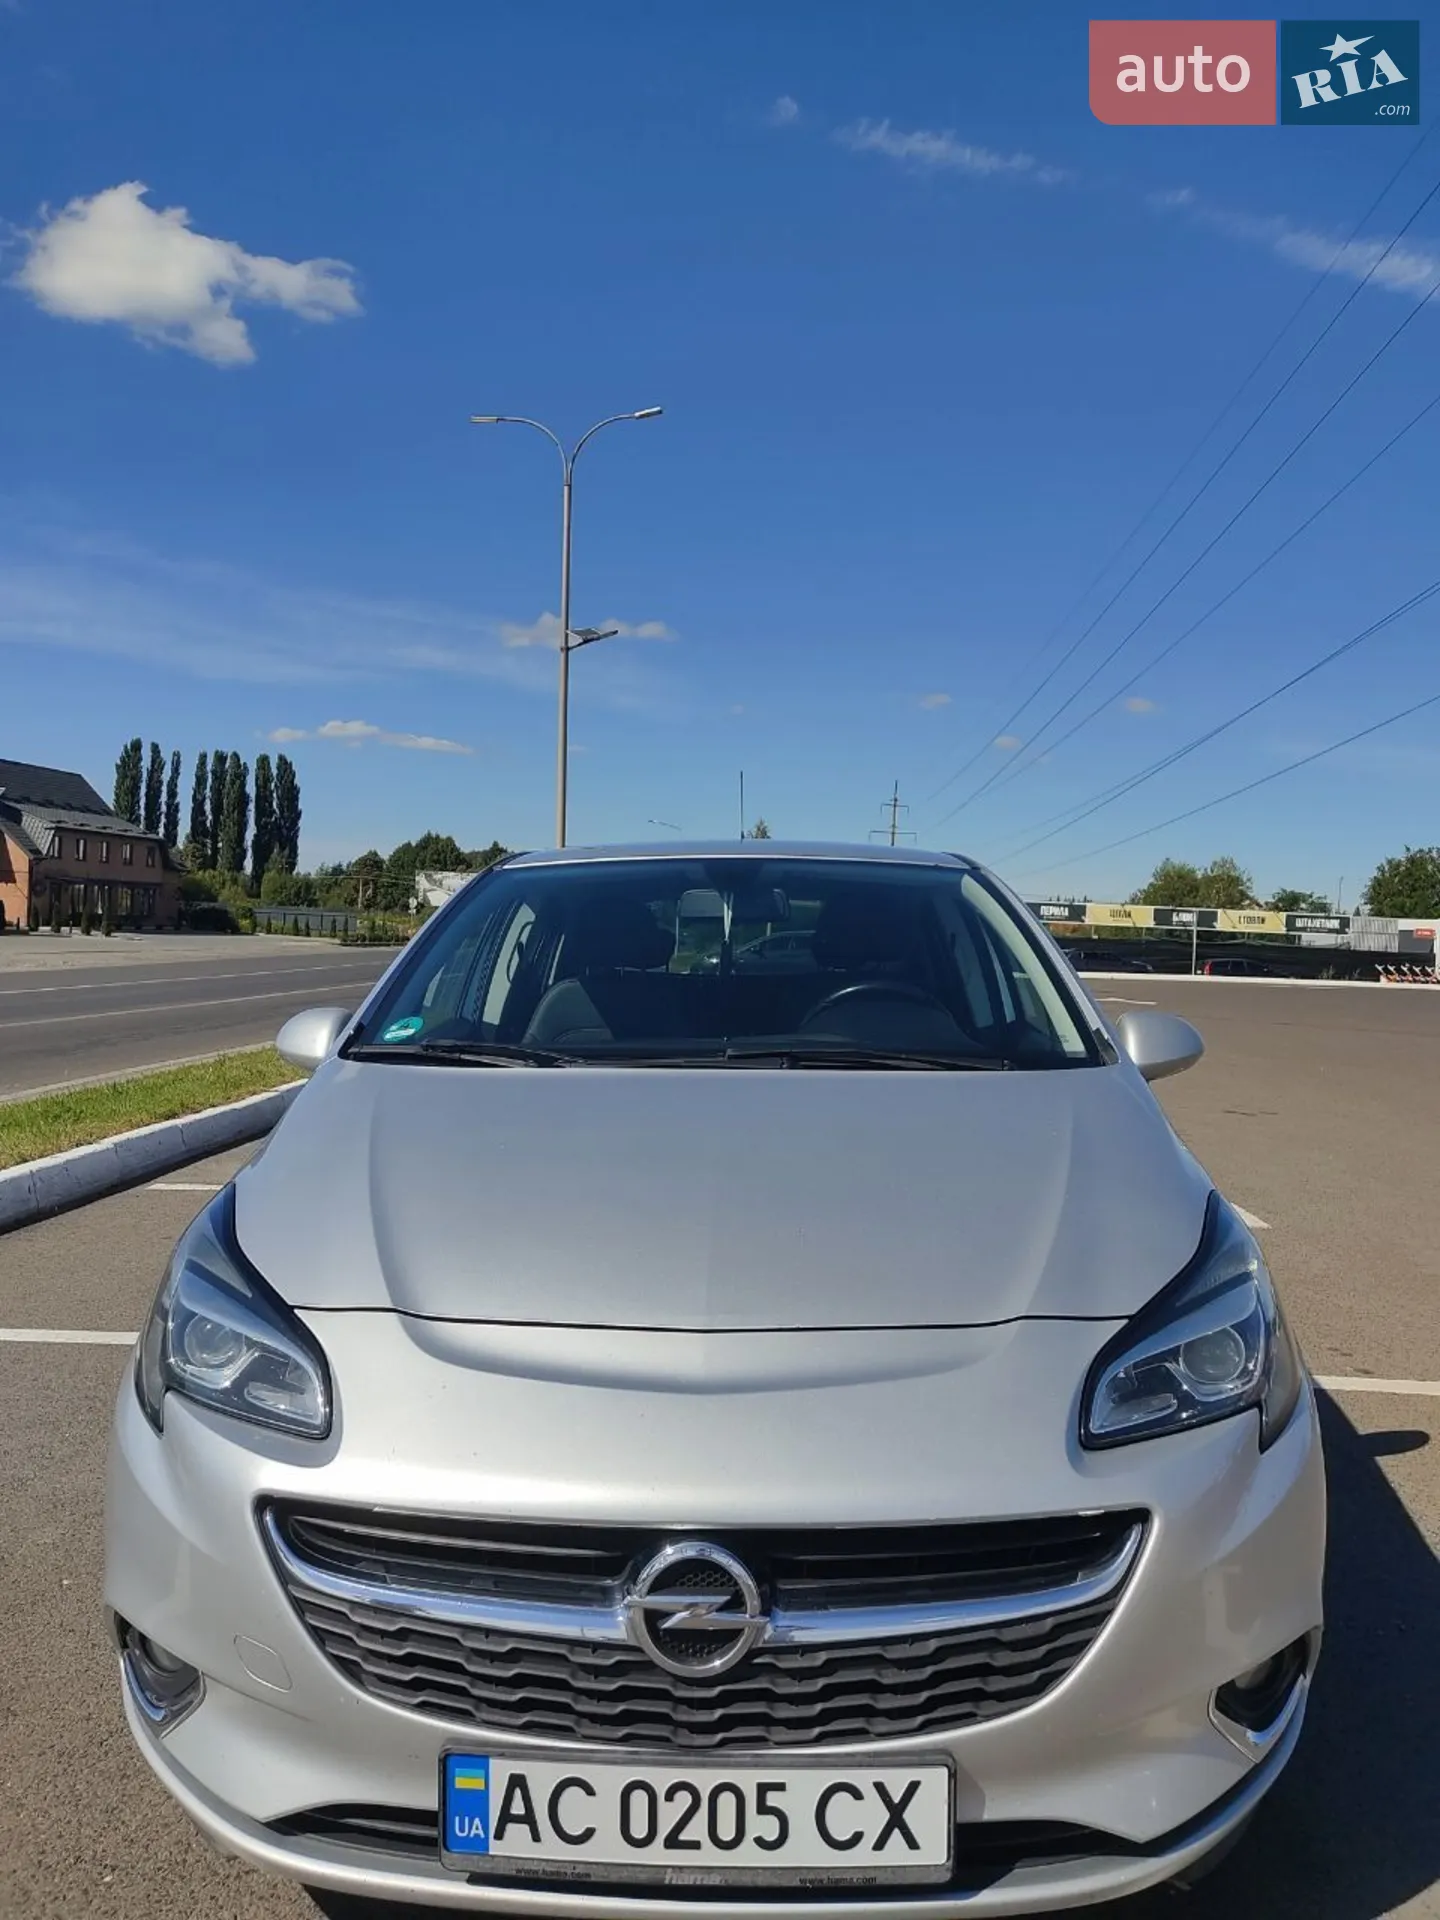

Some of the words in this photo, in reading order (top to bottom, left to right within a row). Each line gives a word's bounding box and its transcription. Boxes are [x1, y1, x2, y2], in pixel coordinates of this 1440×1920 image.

[1172, 911, 1198, 922] БЛОК
[493, 1773, 597, 1846] AC
[619, 1780, 790, 1852] 0205
[814, 1780, 922, 1852] CX
[455, 1817, 485, 1839] UA
[799, 1875, 877, 1885] www.hama.com
